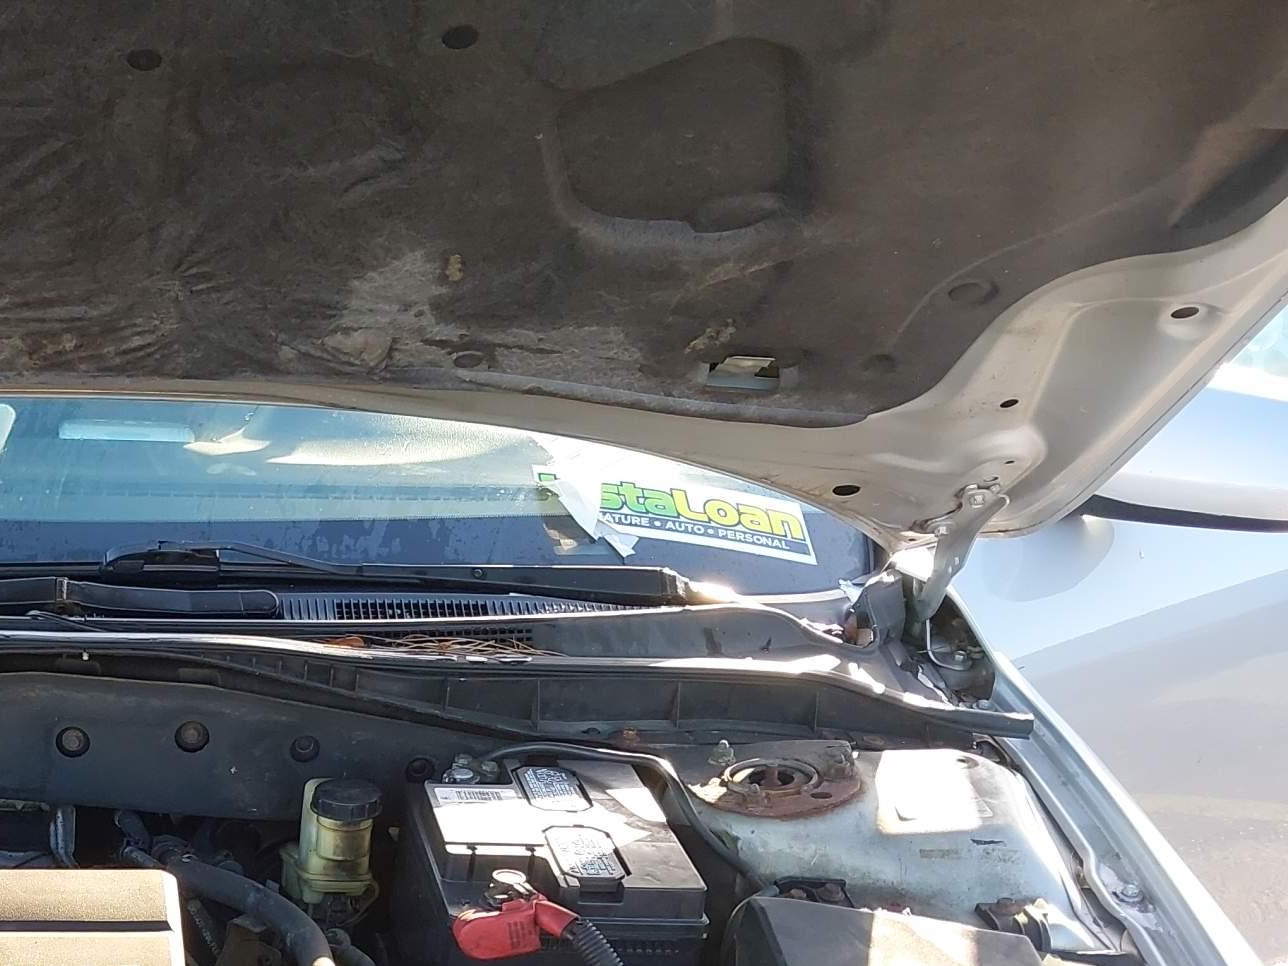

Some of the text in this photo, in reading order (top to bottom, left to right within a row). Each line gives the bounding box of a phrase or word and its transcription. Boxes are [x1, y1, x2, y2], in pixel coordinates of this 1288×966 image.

[600, 511, 791, 549] ATURE AUTO PERSONAL
